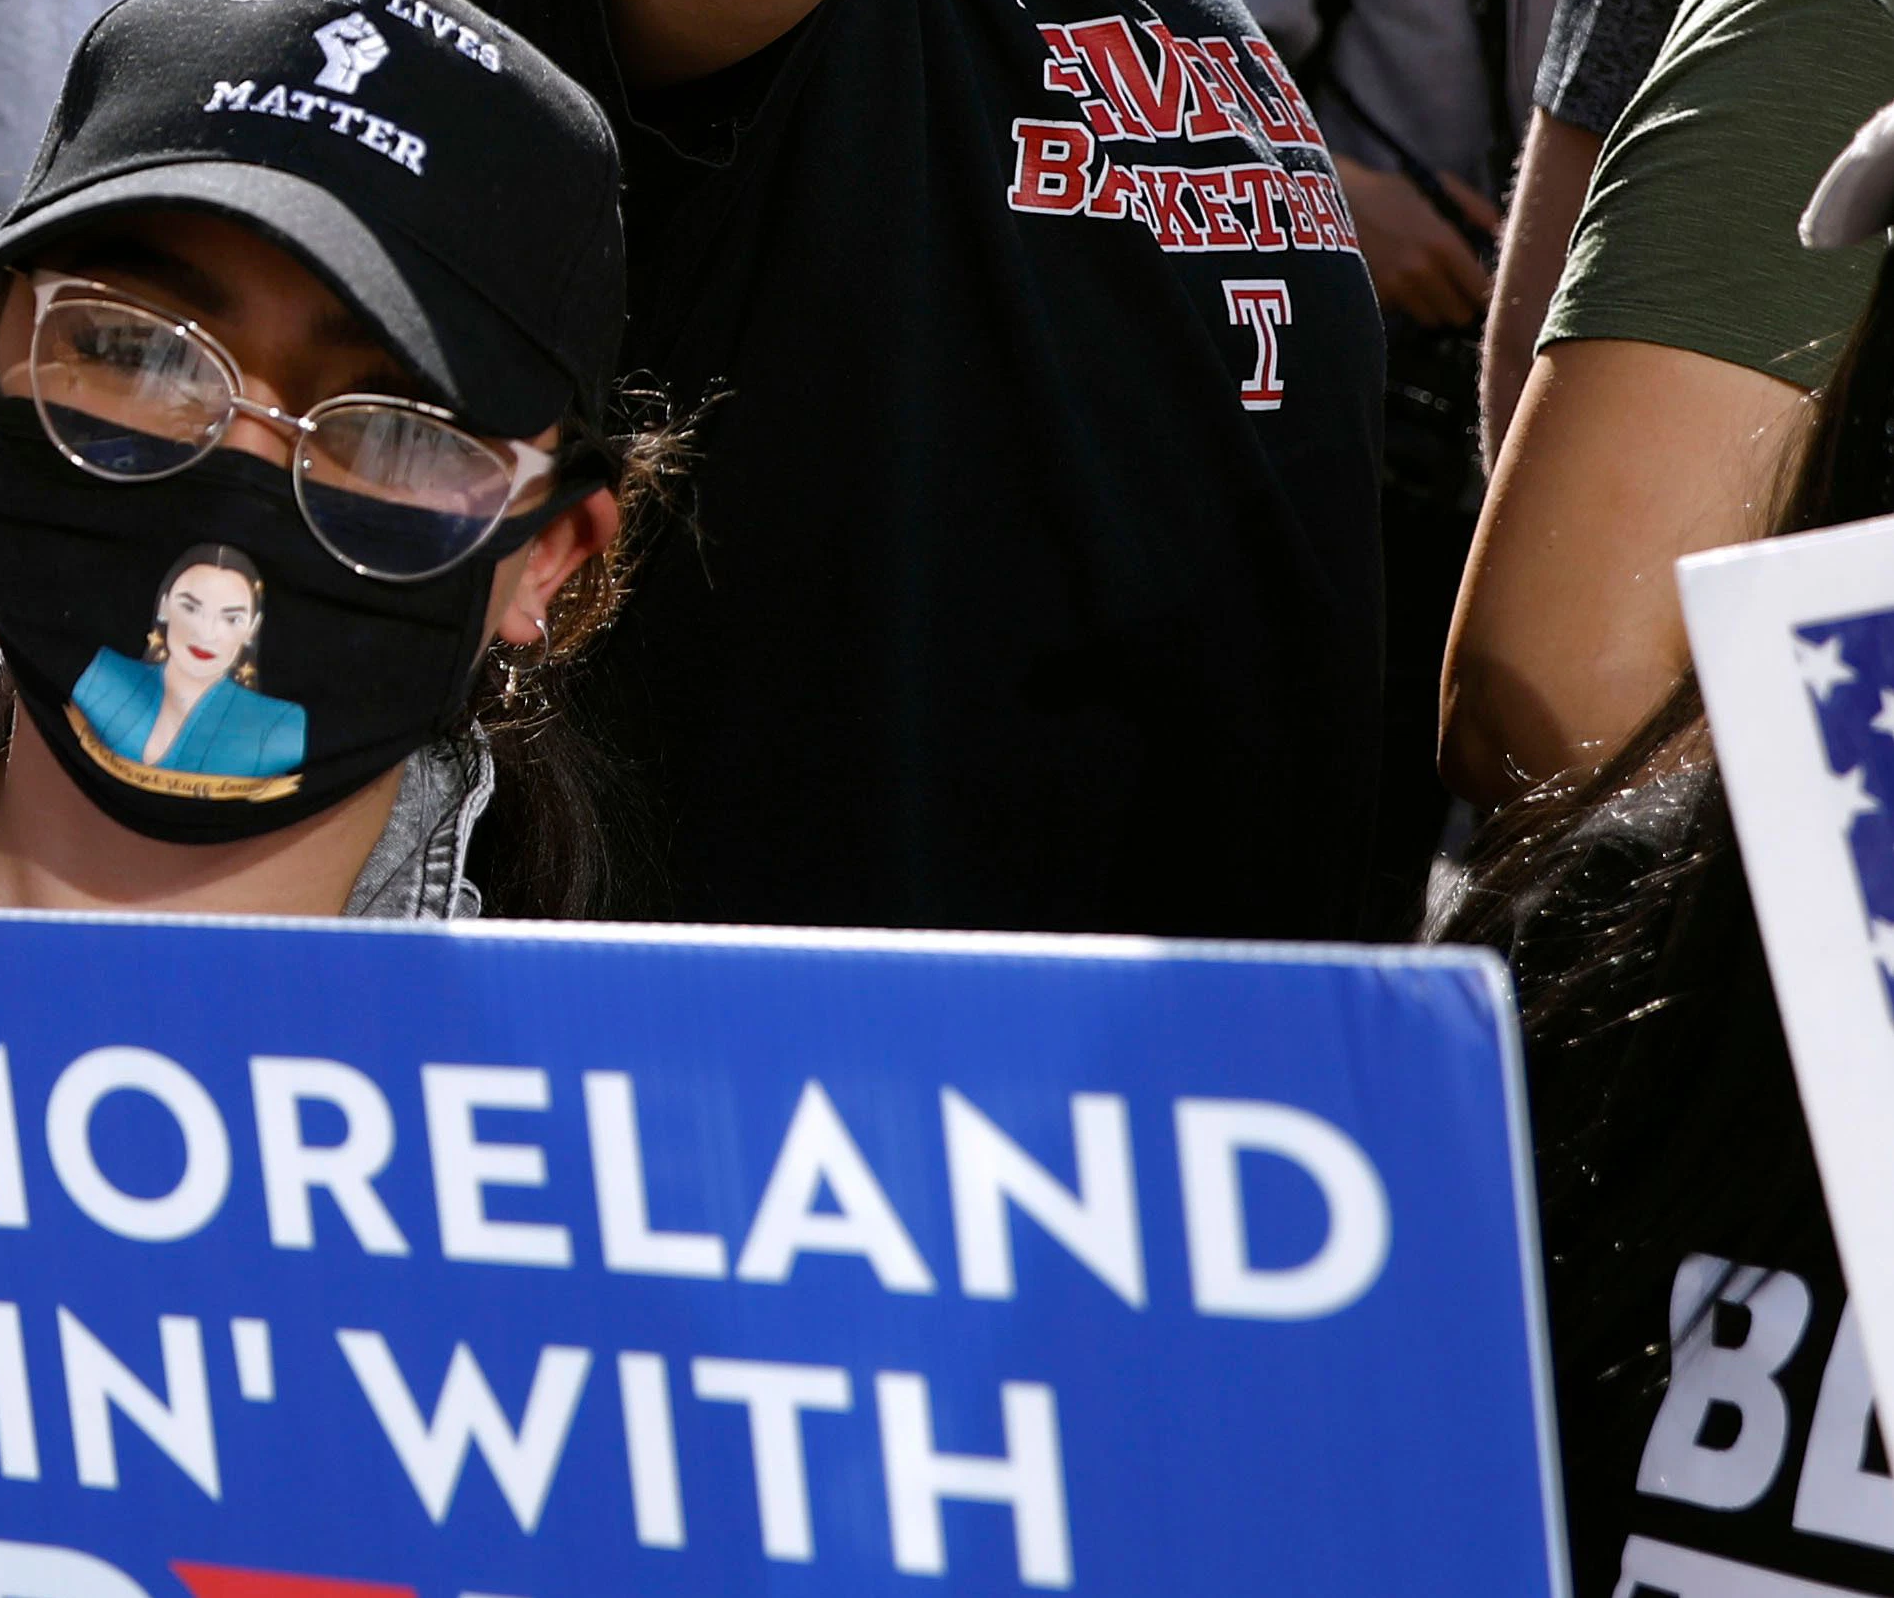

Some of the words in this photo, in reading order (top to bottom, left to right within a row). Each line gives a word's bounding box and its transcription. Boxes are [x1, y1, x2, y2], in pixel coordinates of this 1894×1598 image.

[203, 80, 428, 176] MATTER
[1221, 279, 1293, 412] T
[338, 1329, 1070, 1587] WITH
